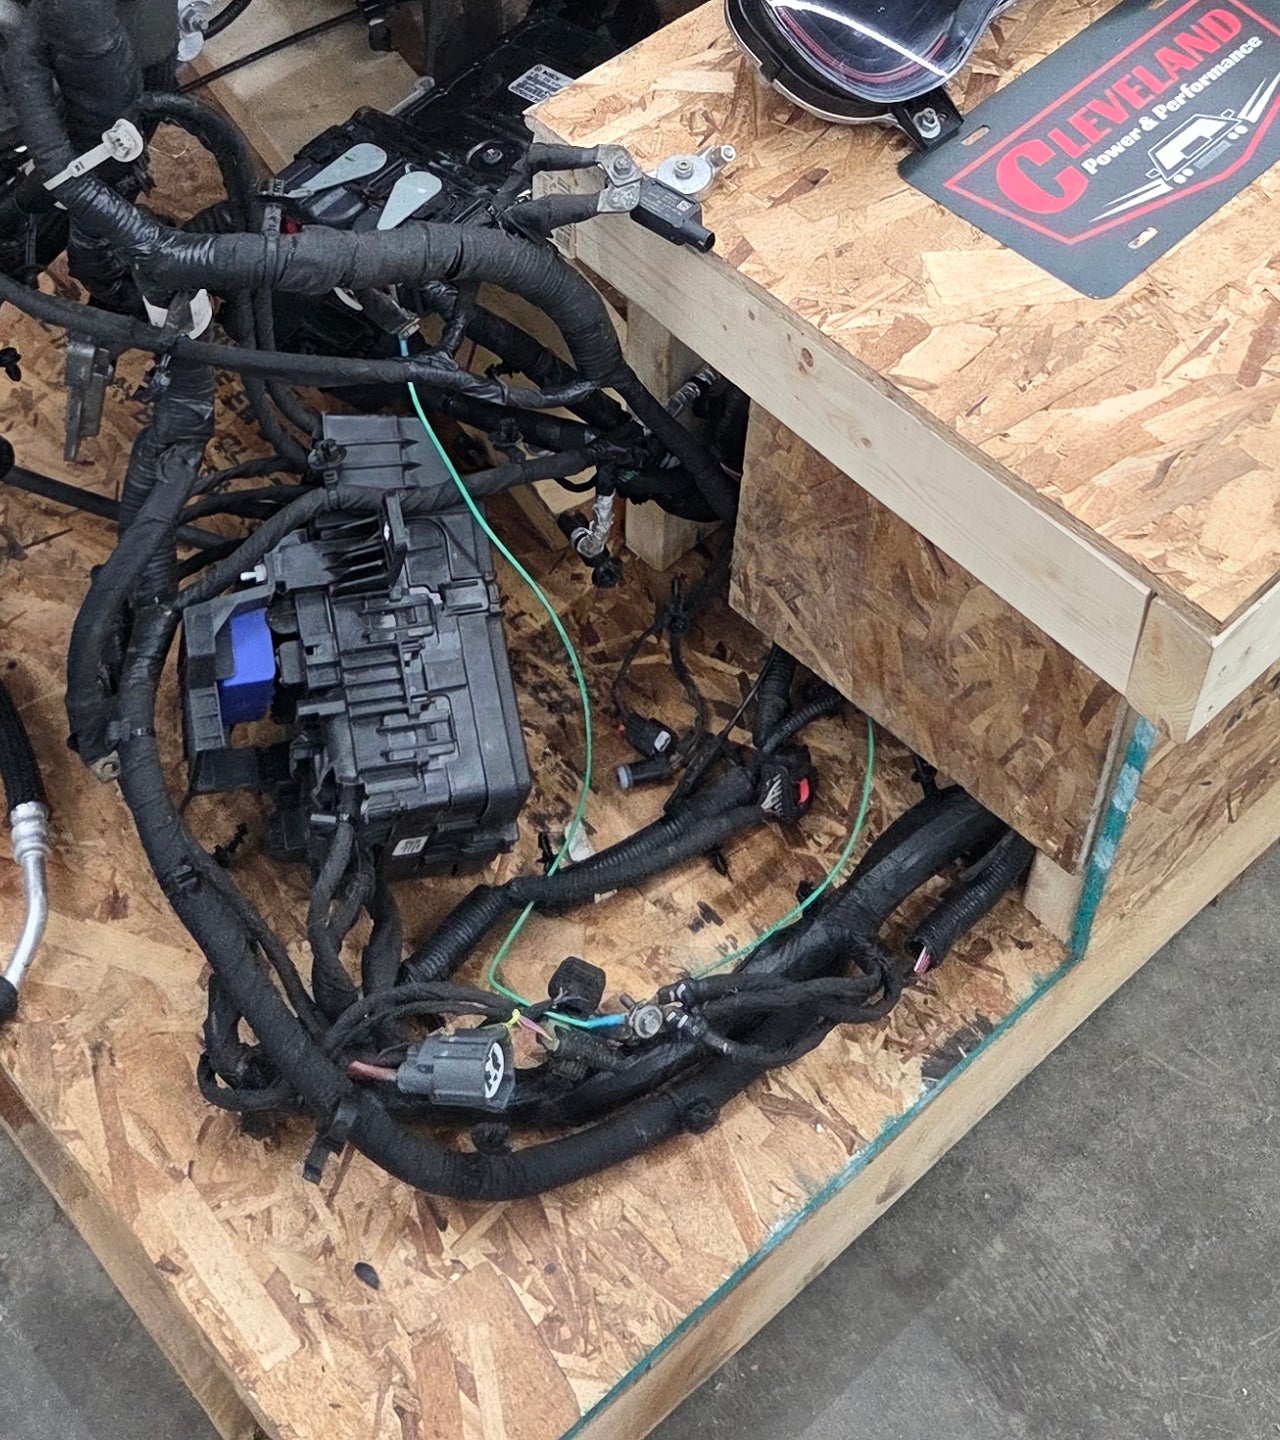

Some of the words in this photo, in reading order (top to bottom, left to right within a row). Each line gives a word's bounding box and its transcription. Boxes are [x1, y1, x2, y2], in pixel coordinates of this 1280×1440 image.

[995, 8, 1243, 215] CLEVELAND
[1080, 125, 1142, 176] Power
[1138, 114, 1161, 132] &
[1151, 35, 1264, 121] Performance
